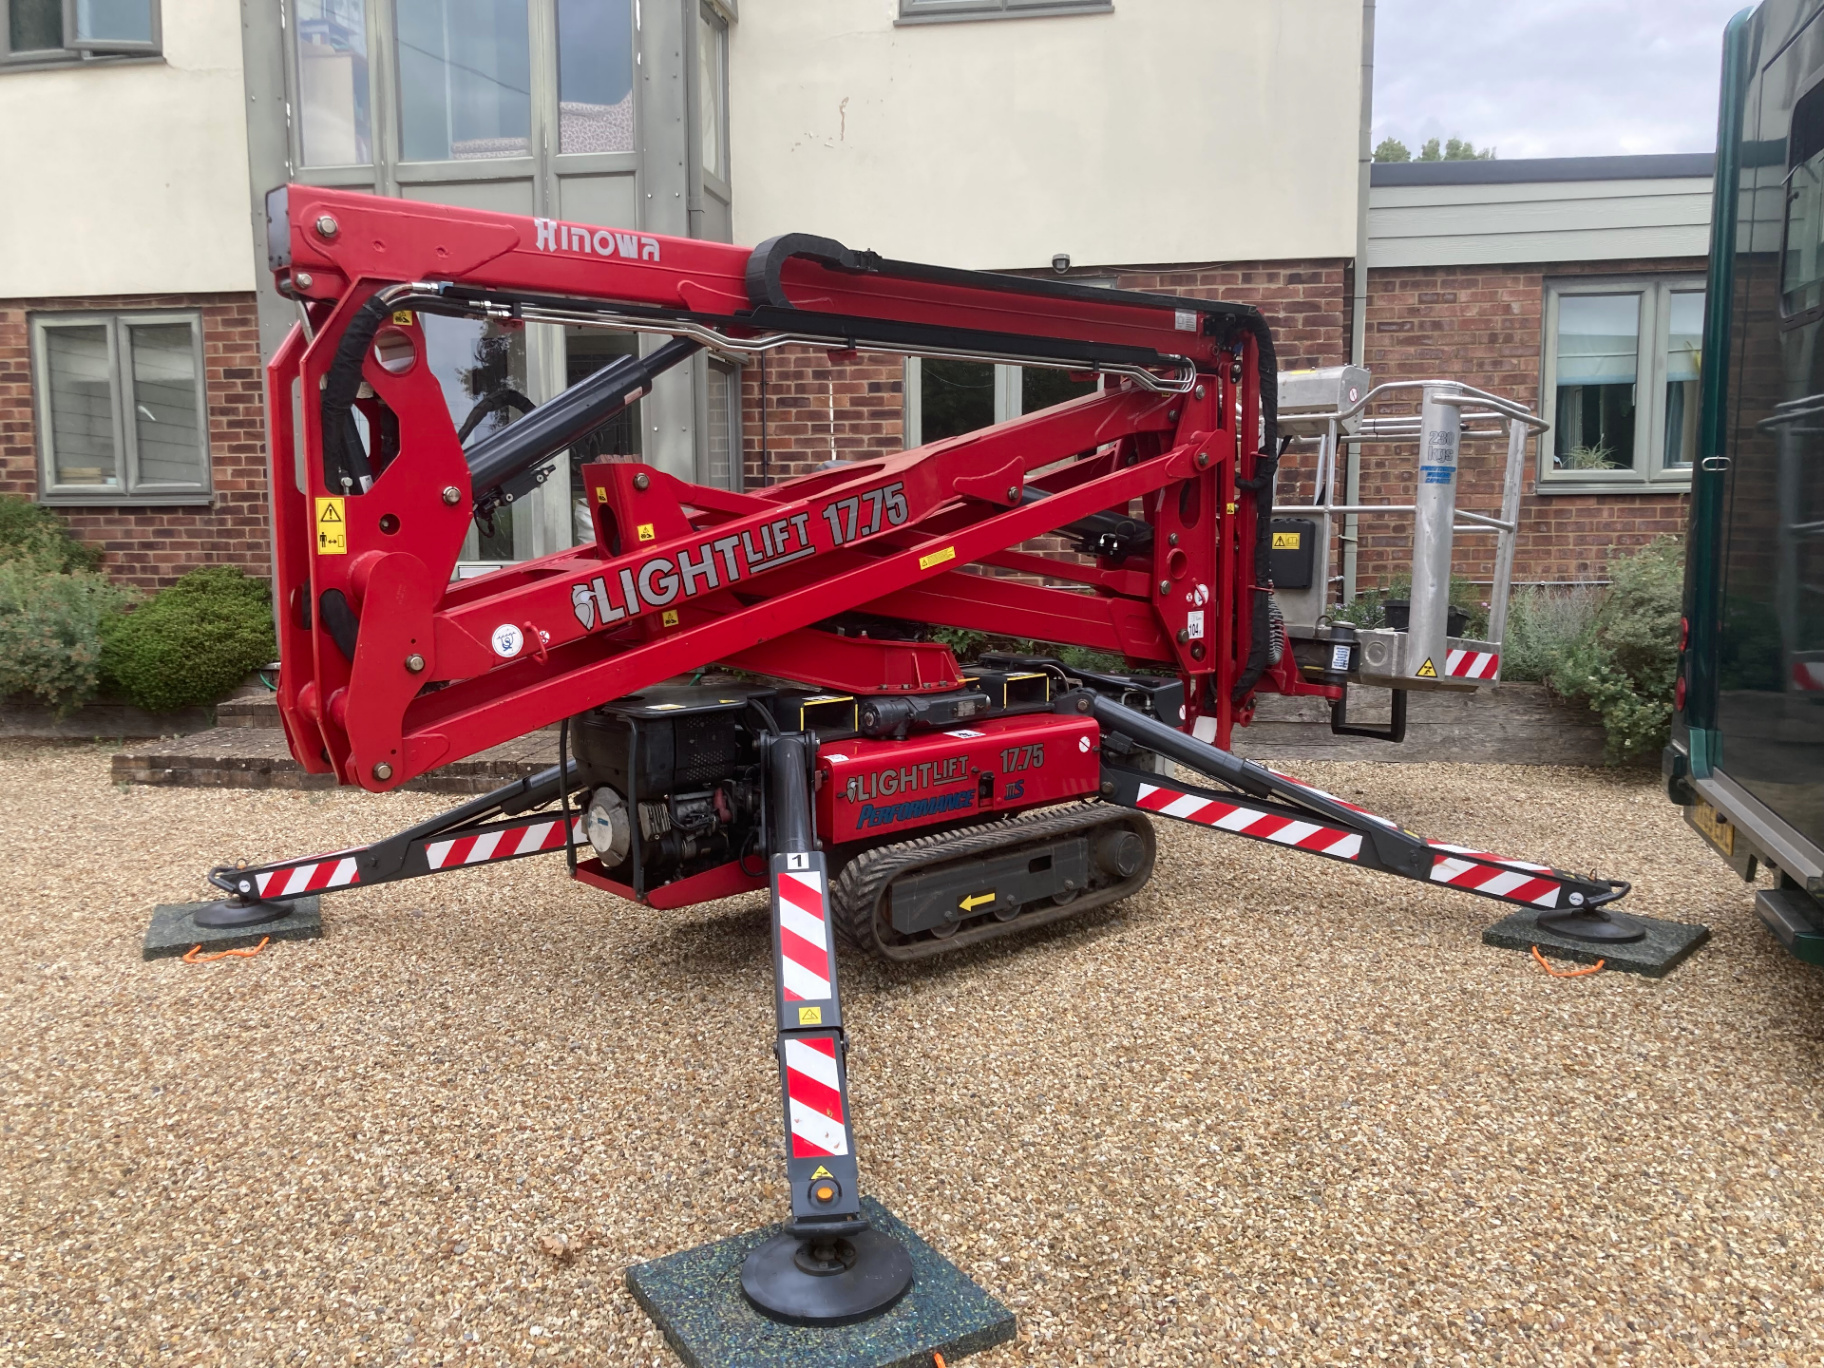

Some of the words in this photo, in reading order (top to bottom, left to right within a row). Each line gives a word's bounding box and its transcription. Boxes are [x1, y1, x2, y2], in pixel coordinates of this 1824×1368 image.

[1428, 430, 1455, 446] 230
[1427, 445, 1454, 464] kgs
[821, 481, 910, 548] 17.75
[1188, 622, 1199, 637] 104
[999, 743, 1045, 774] 17.75
[856, 788, 977, 830] PERFORMANCE
[792, 854, 802, 868] 1
